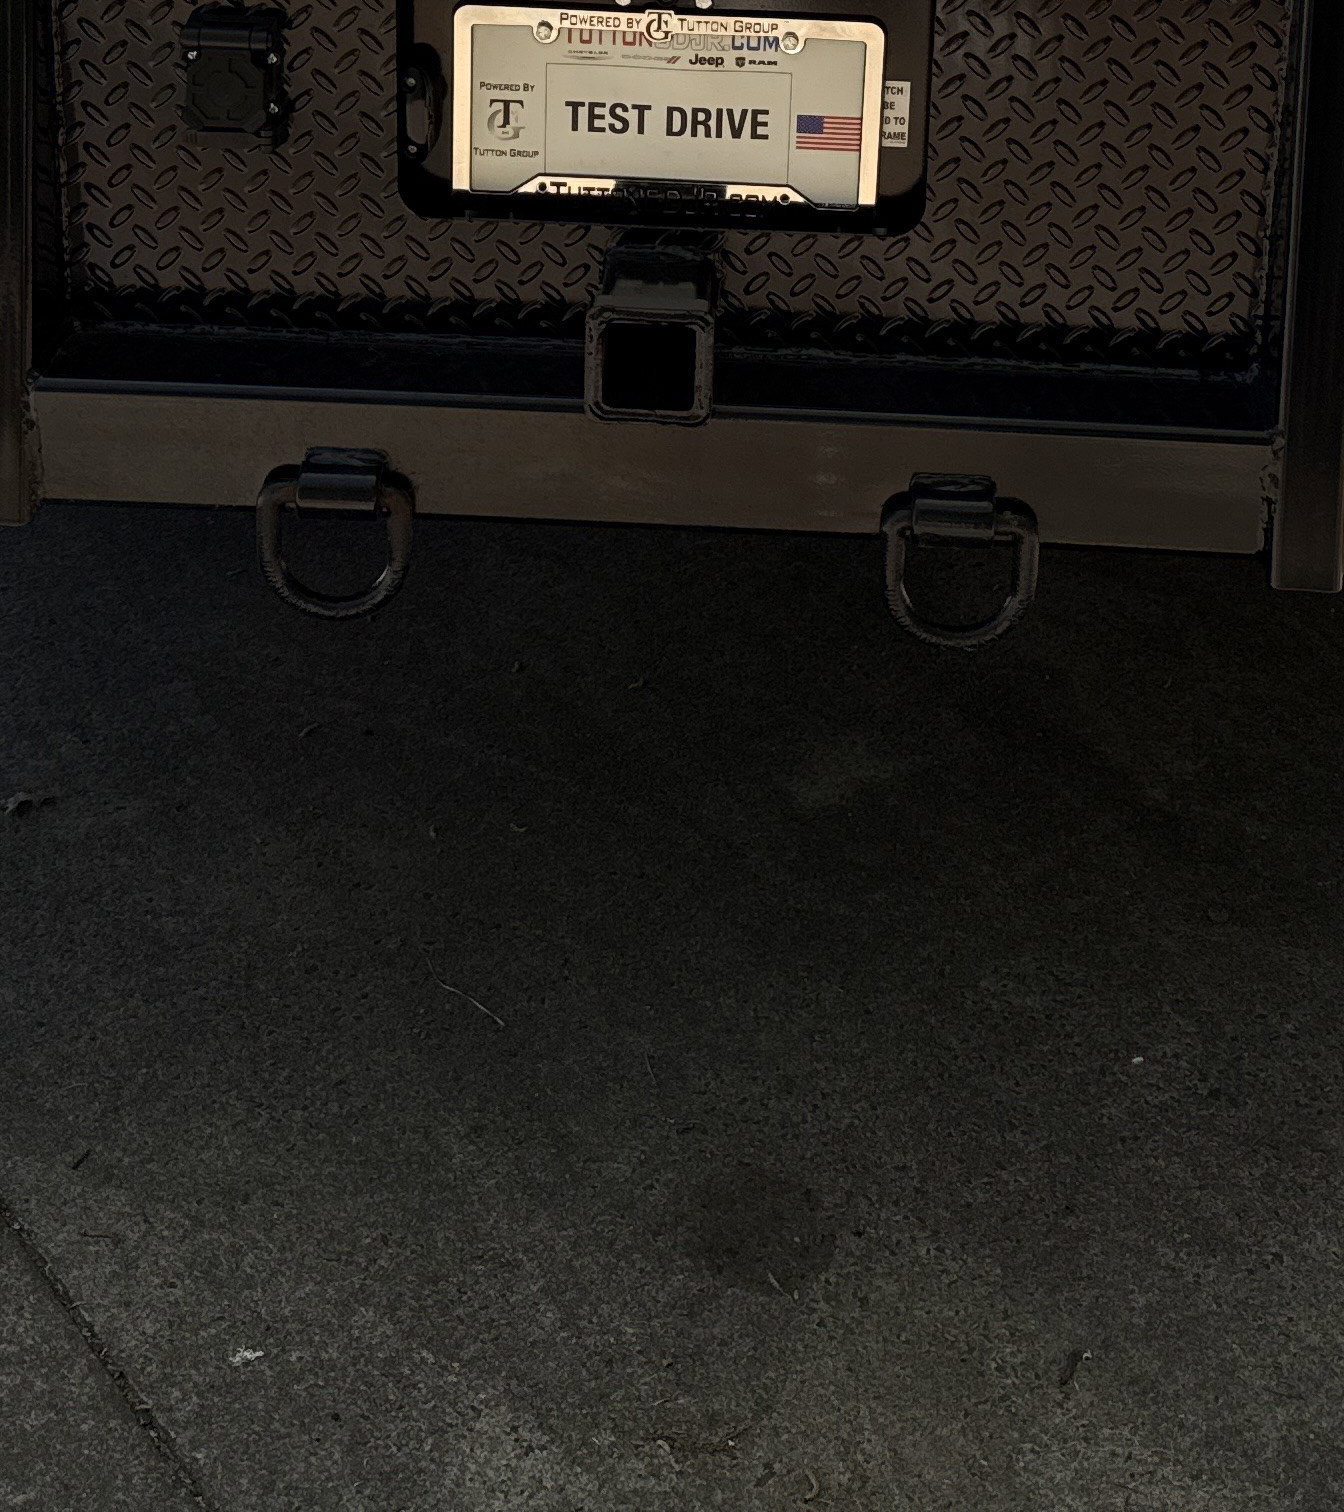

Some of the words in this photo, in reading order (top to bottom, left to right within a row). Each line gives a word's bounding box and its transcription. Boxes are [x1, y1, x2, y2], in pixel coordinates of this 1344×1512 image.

[689, 53, 725, 68] Jeep
[565, 101, 652, 135] TEST
[666, 105, 770, 140] DRIVE
[893, 117, 906, 125] TO
